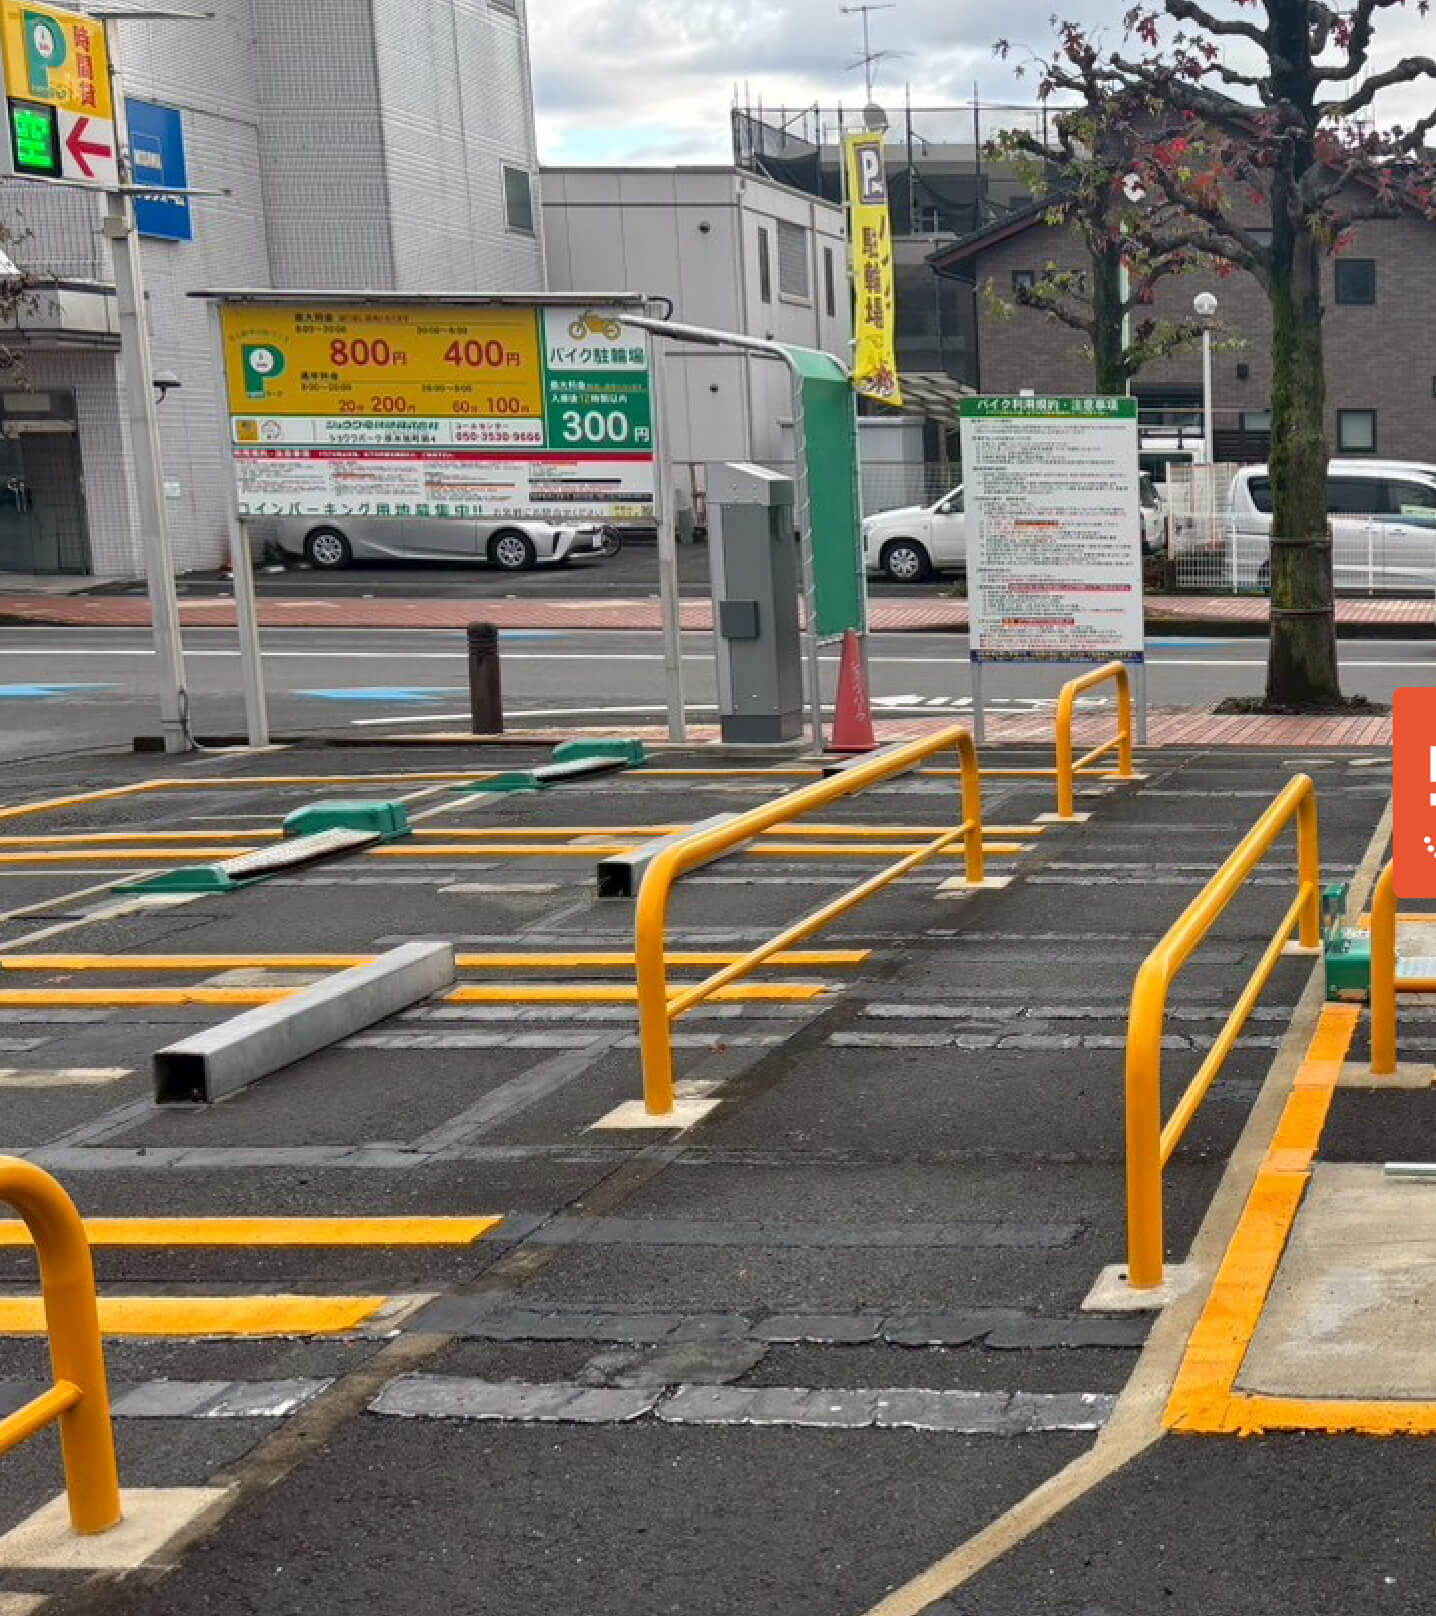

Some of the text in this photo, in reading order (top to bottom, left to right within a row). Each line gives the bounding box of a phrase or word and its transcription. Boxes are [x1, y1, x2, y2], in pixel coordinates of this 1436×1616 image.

[330, 338, 520, 367] 800円 400円
[550, 347, 644, 364] バイク駐輪場
[371, 395, 417, 413] 200円
[486, 397, 531, 414] 100円
